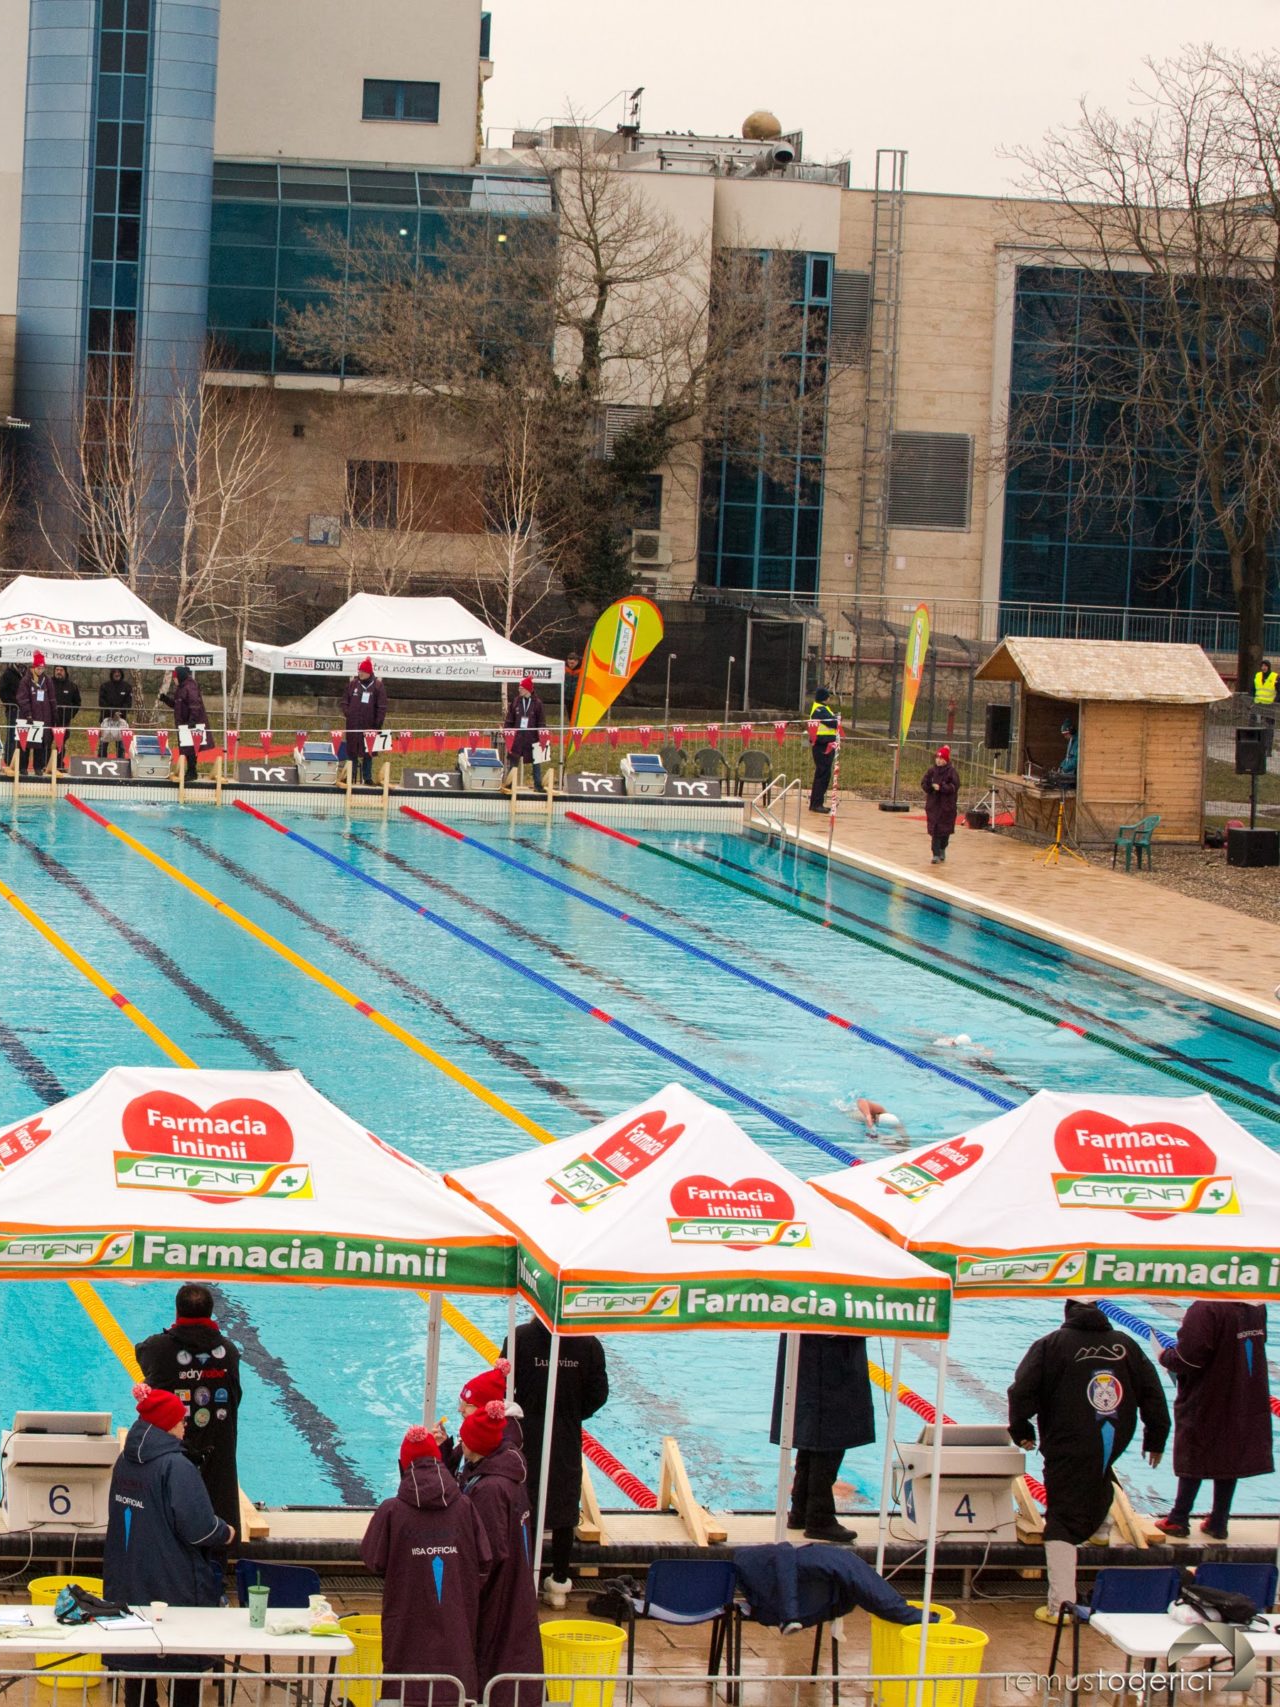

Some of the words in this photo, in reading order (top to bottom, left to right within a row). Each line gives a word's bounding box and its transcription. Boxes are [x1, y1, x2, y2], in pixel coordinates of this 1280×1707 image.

[20, 618, 71, 635] STAR
[79, 624, 142, 636] STONE
[358, 640, 409, 654] STAR
[416, 643, 479, 655] STONE
[96, 654, 102, 662] e
[106, 654, 140, 663] Beton!
[163, 656, 184, 664] STAR
[186, 656, 213, 665] STONE
[293, 660, 314, 669] STAR
[316, 661, 342, 670] STONE
[436, 666, 442, 674] e
[446, 666, 478, 675] Beton!
[502, 668, 522, 677] STAR
[524, 668, 550, 678] STONE
[31, 725, 40, 741] 7
[380, 733, 388, 750] 7
[82, 761, 119, 775] TYR
[250, 767, 286, 782] TYR
[414, 772, 450, 788] TYR
[578, 778, 615, 792] TYR
[674, 782, 708, 796] TYR
[147, 1109, 266, 1136] Farmacia
[625, 1122, 668, 1156] Farmacia
[1076, 1128, 1190, 1149] Farmacia
[172, 1136, 247, 1160] inimii
[936, 1144, 970, 1166] Farmacia
[605, 1146, 640, 1173] inimii
[1103, 1154, 1174, 1174] inimii
[136, 1164, 255, 1187] CATENA
[564, 1166, 604, 1192] CATENA
[688, 1186, 775, 1204] Farmacia
[1074, 1184, 1184, 1202] CATENA
[708, 1202, 763, 1218] inimii
[683, 1224, 771, 1238] CATENA
[8, 1243, 93, 1258] CATENA
[142, 1236, 324, 1270] Farmacia
[334, 1242, 447, 1278] inimii
[970, 1262, 1050, 1278] CATENA
[1094, 1254, 1260, 1286] Farmacia
[576, 1296, 646, 1308] CATENA
[687, 1288, 836, 1317] Farmacia
[845, 1293, 936, 1322] inimii
[534, 1357, 579, 1368] Luvine
[48, 1484, 72, 1515] 6
[954, 1494, 976, 1524] 4
